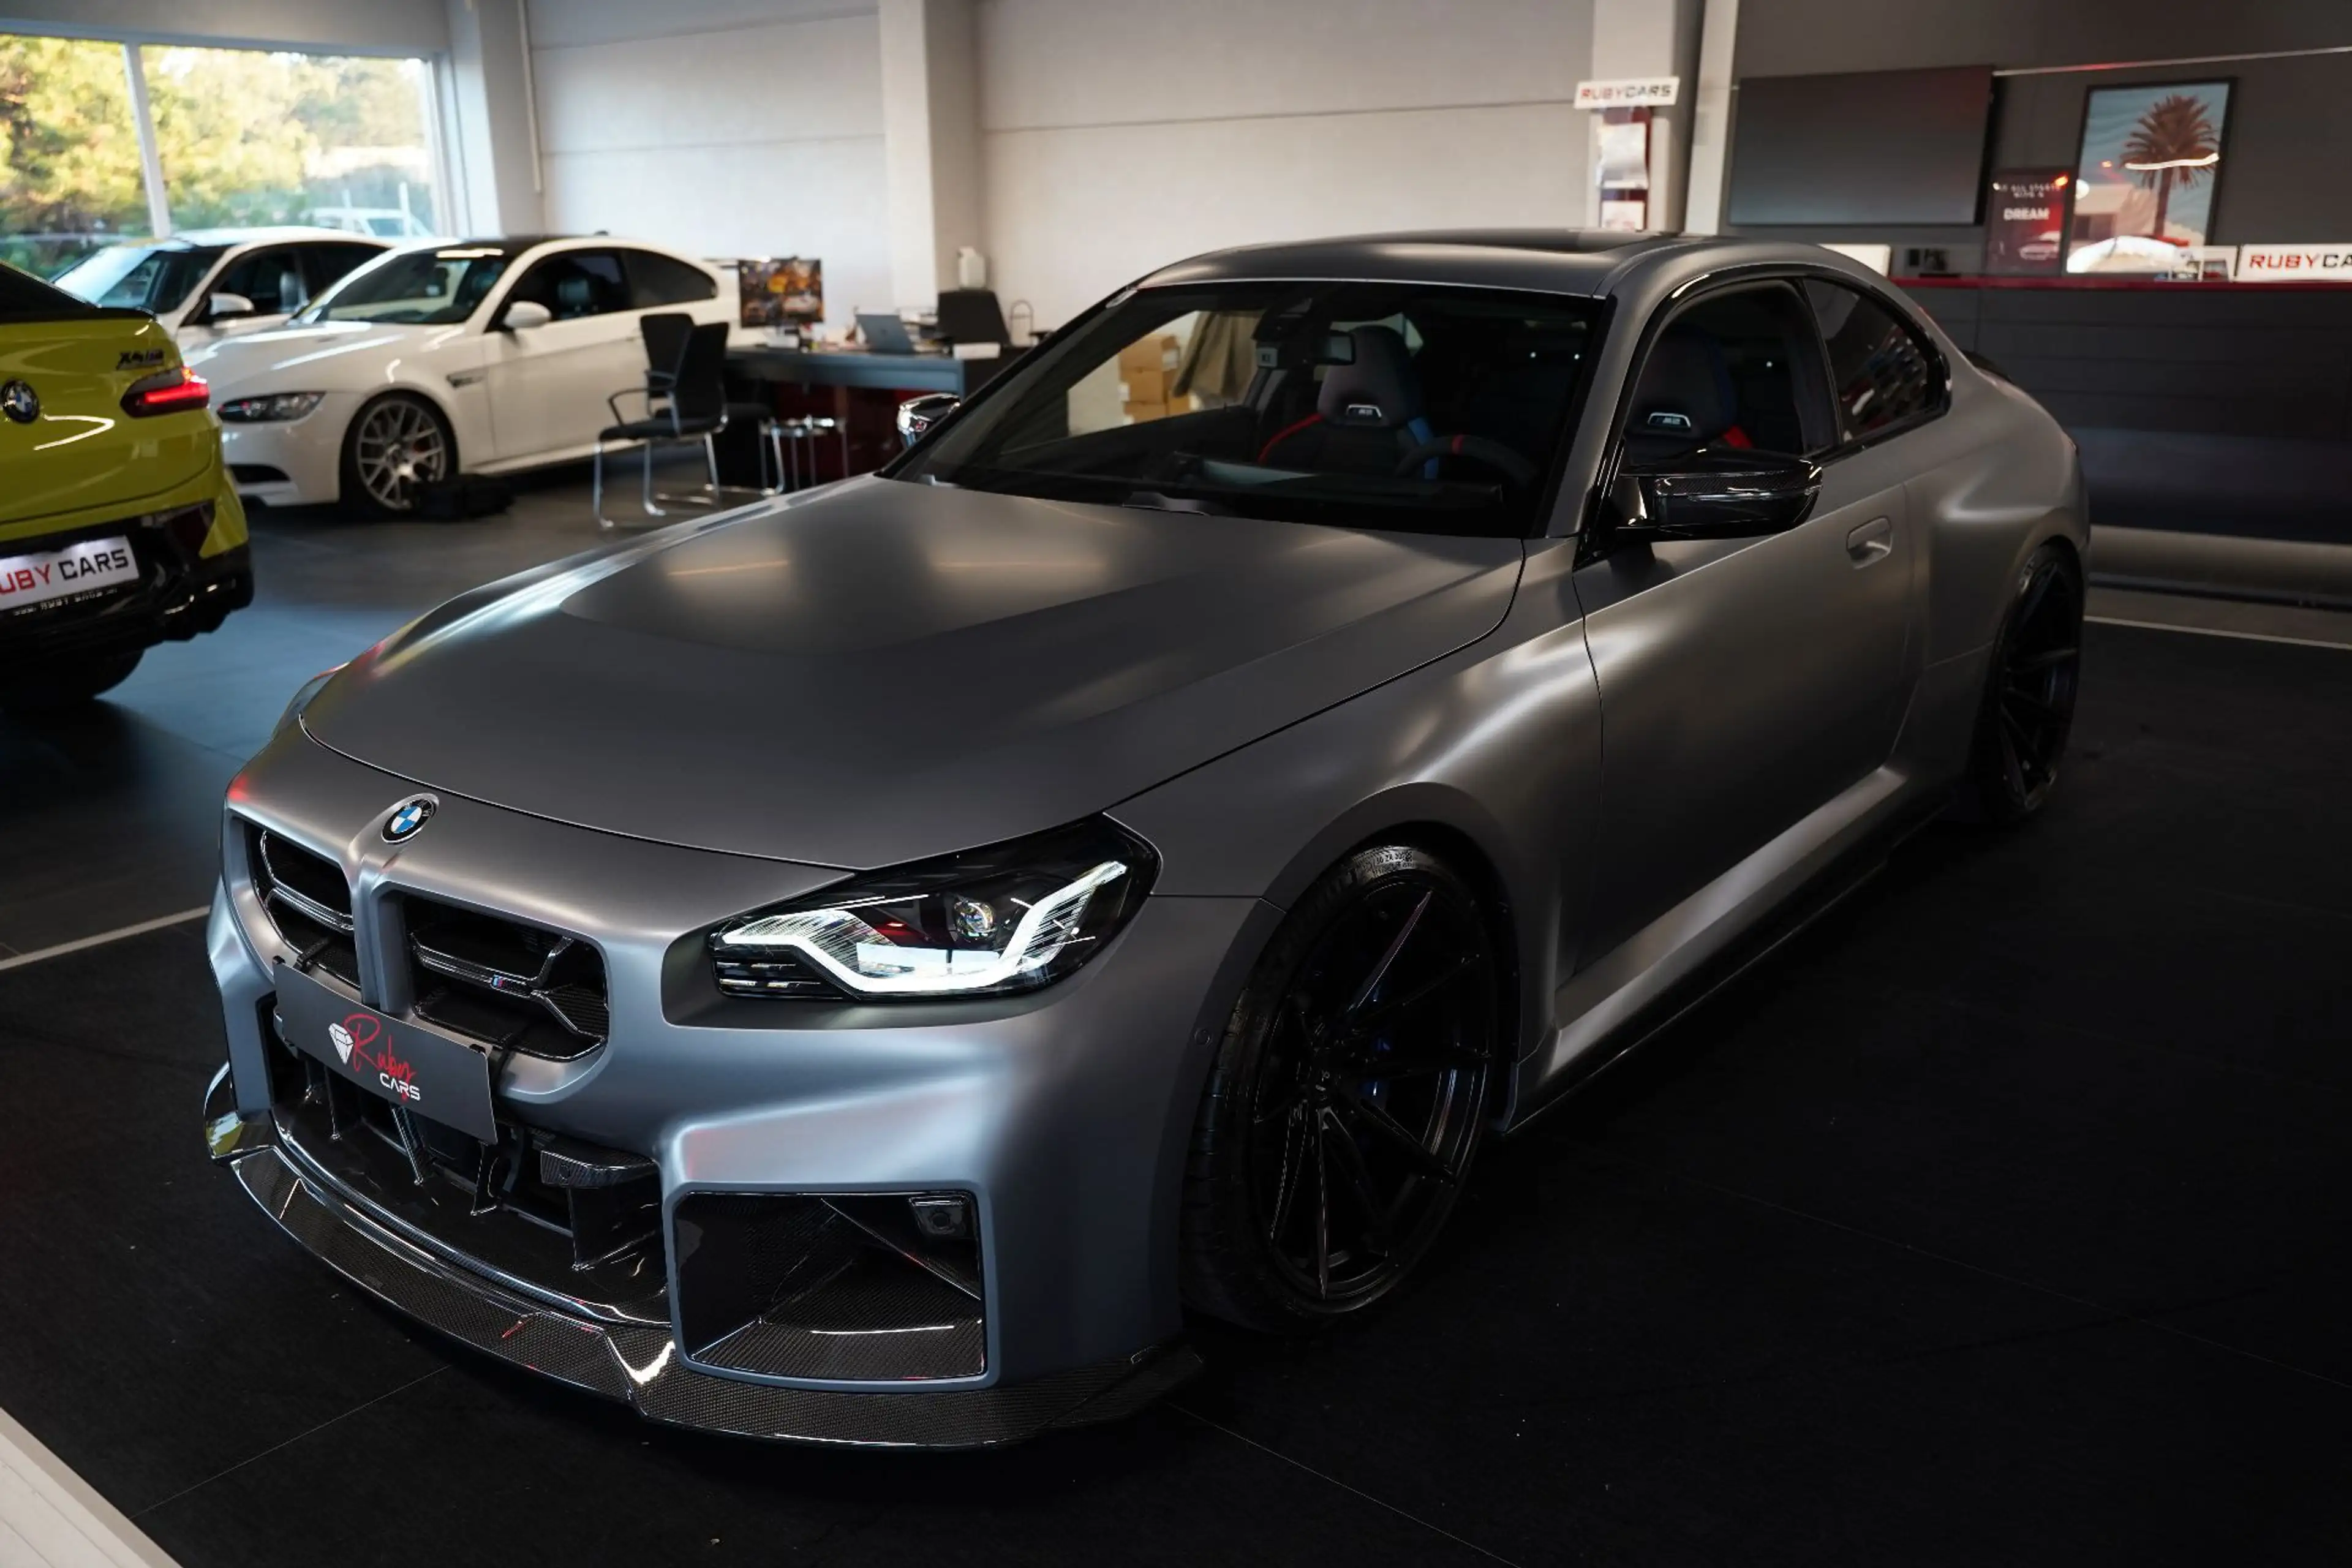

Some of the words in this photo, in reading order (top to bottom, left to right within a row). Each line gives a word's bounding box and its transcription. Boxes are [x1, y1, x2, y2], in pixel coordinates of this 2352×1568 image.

[1581, 85, 1672, 100] RUBYCARS
[2003, 208, 2049, 221] DREAM
[58, 549, 129, 581] CARS
[343, 1014, 417, 1102] Ruby
[379, 1072, 421, 1101] CARS
